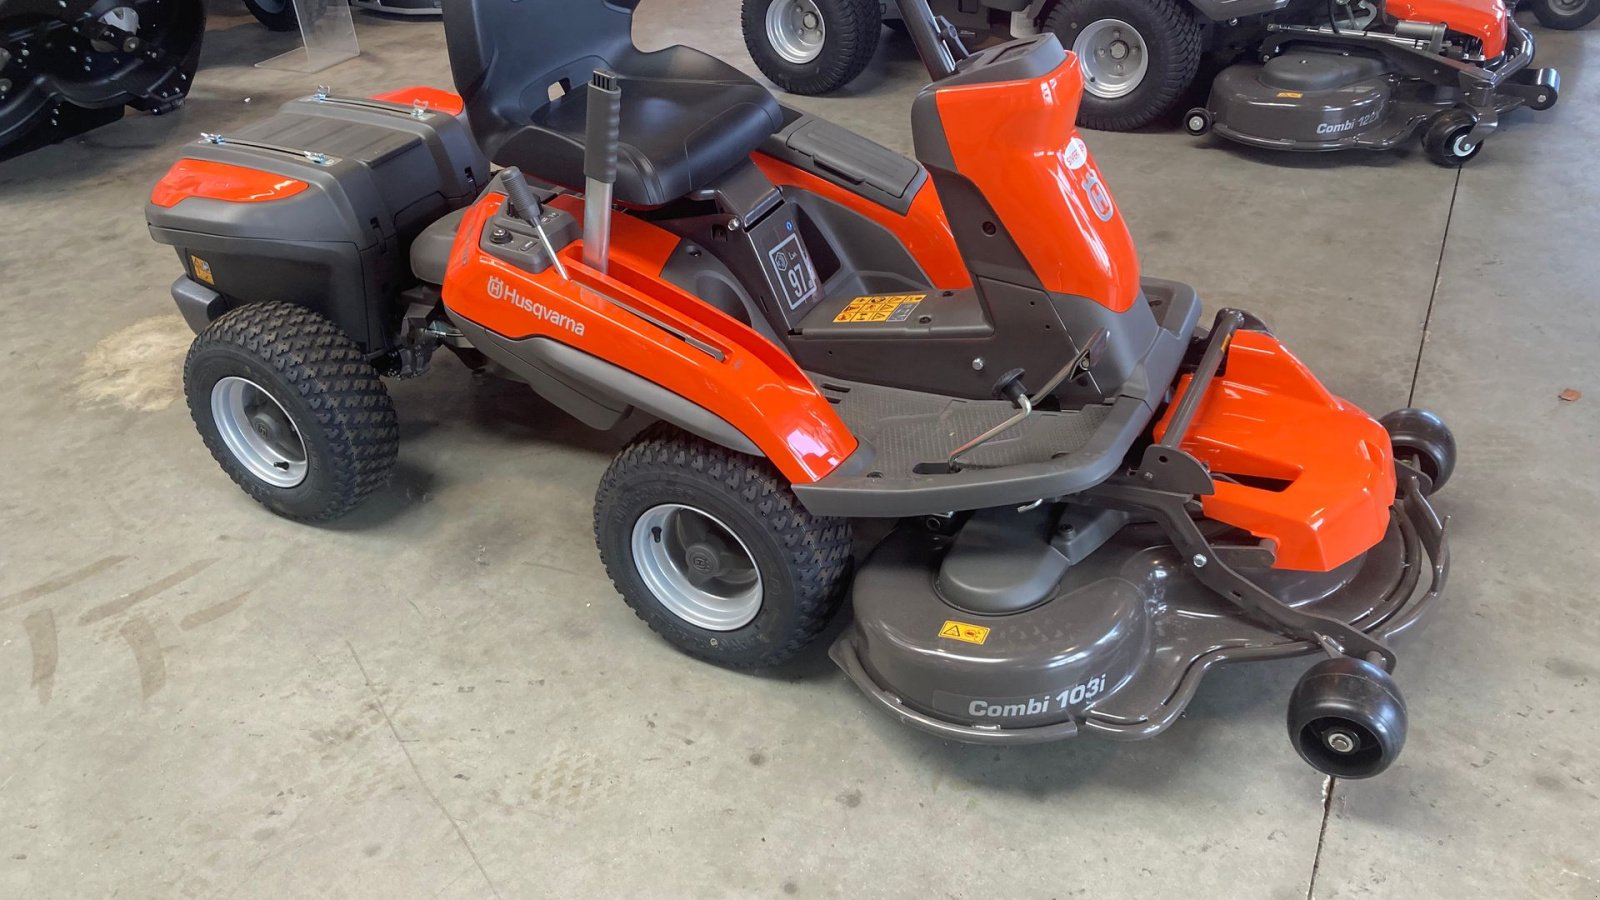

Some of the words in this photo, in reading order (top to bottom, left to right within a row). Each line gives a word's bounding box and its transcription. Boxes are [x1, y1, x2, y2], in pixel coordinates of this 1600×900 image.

[1316, 119, 1355, 134] Combi
[788, 263, 807, 298] 97
[503, 285, 585, 337] Husqvarna
[968, 695, 1050, 717] Combi
[1056, 673, 1107, 708] 103i
